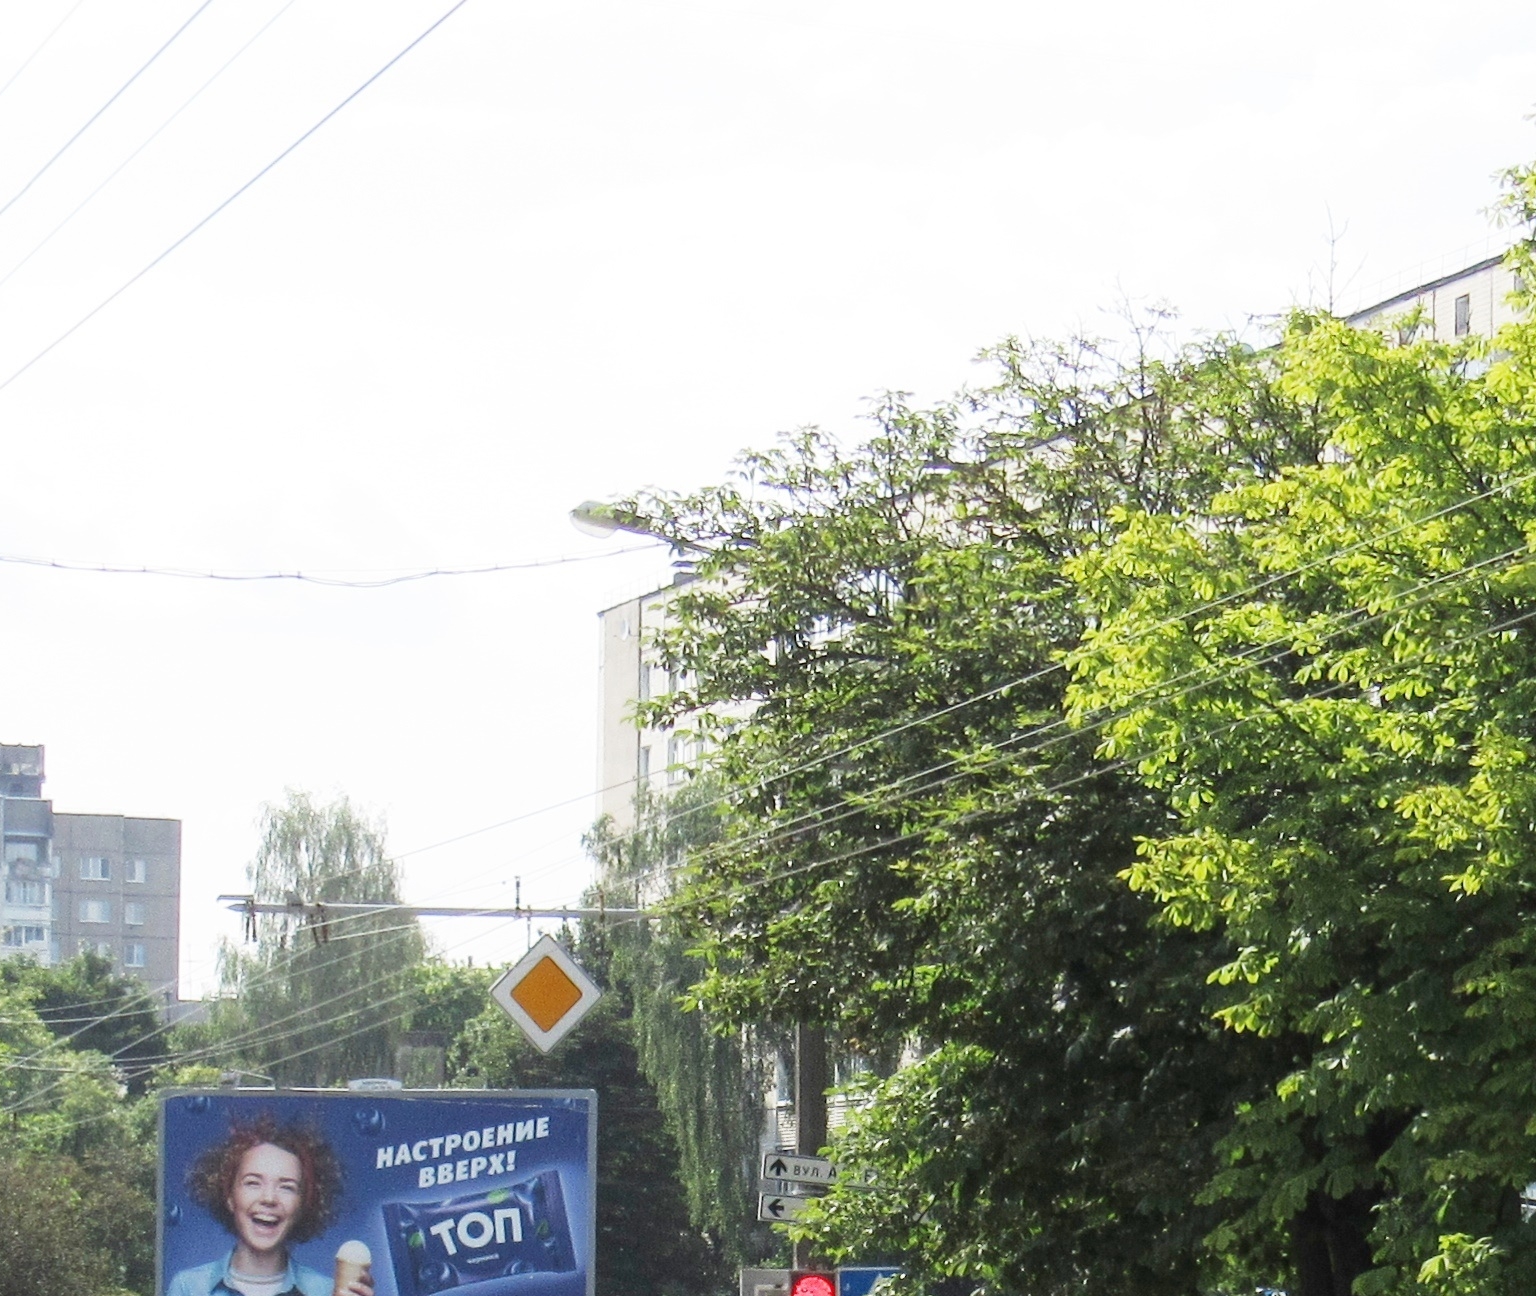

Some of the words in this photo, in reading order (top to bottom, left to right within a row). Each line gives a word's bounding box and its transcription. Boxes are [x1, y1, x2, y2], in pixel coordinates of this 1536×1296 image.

[376, 1116, 550, 1169] НАСТРОЕНИЕ
[418, 1150, 517, 1188] ВВЕРХ!
[430, 1207, 523, 1256] ТОП
